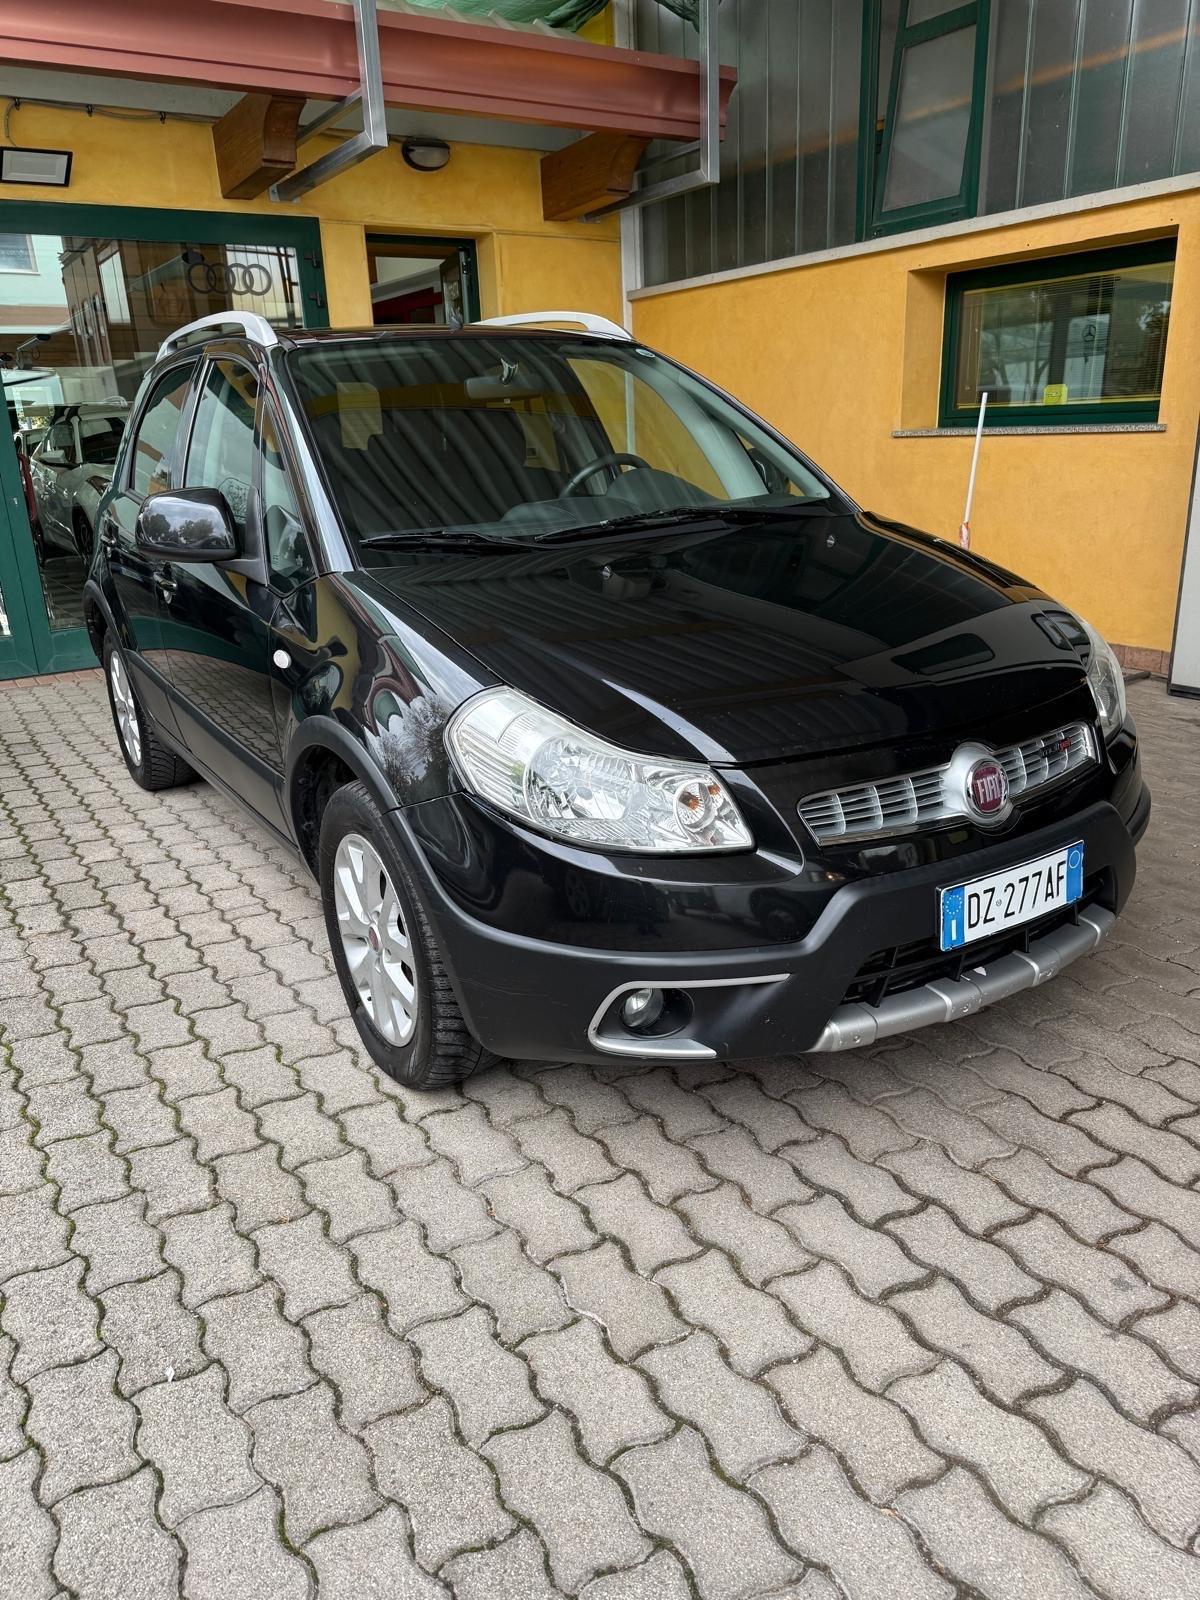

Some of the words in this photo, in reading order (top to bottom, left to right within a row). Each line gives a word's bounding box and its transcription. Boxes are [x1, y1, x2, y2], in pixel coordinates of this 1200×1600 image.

[976, 771, 1001, 804] FIAT
[967, 886, 996, 930] DZ
[1003, 860, 1067, 919] 277AF
